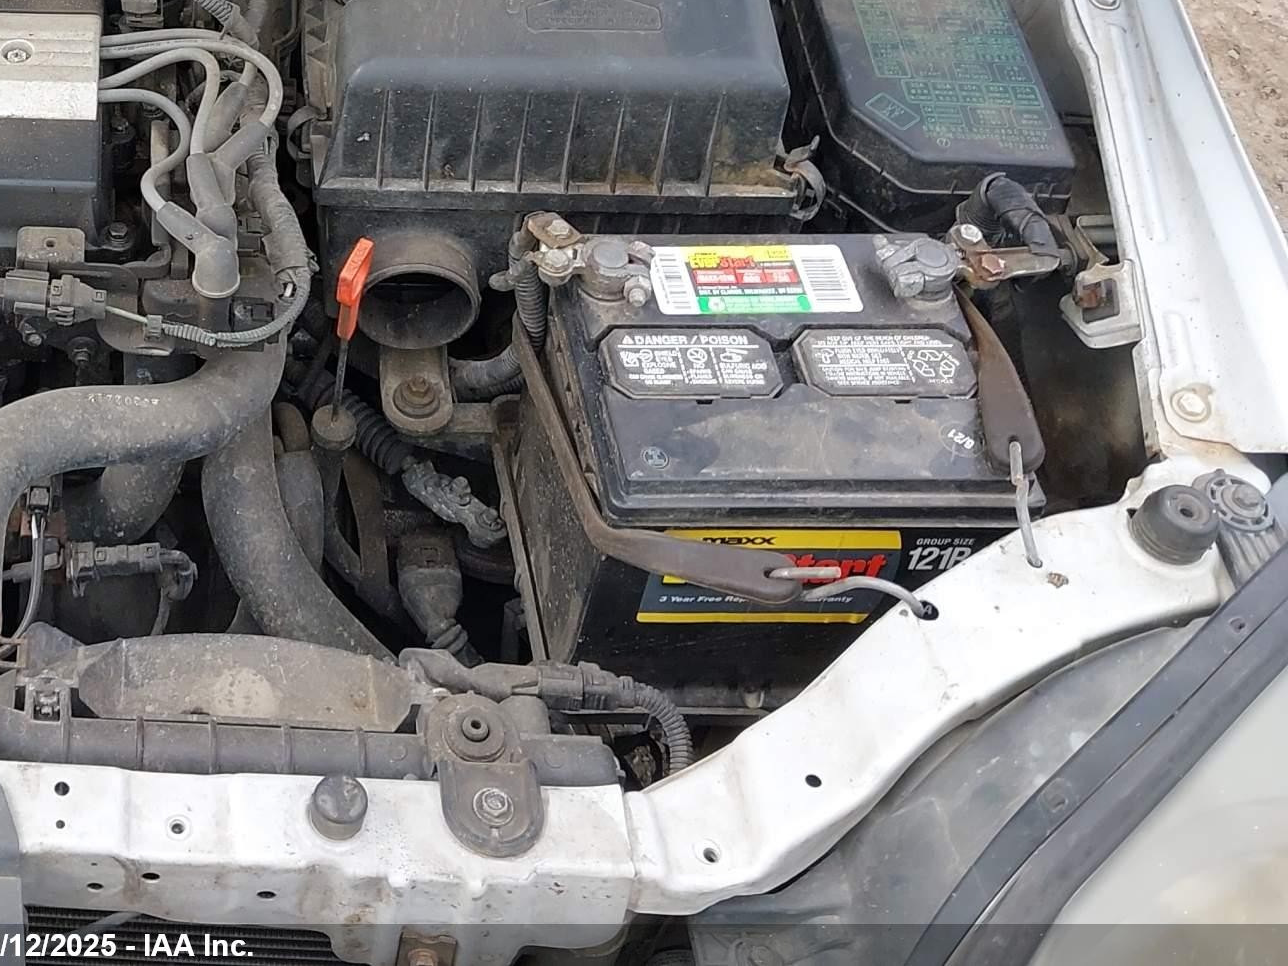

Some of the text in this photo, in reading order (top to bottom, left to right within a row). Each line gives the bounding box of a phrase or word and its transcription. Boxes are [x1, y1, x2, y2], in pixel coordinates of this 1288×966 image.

[634, 335, 749, 345] DANGER / POISON
[916, 538, 951, 546] GROUP
[658, 595, 668, 603] 3
[671, 595, 695, 603] Year
[696, 595, 722, 603] Free
